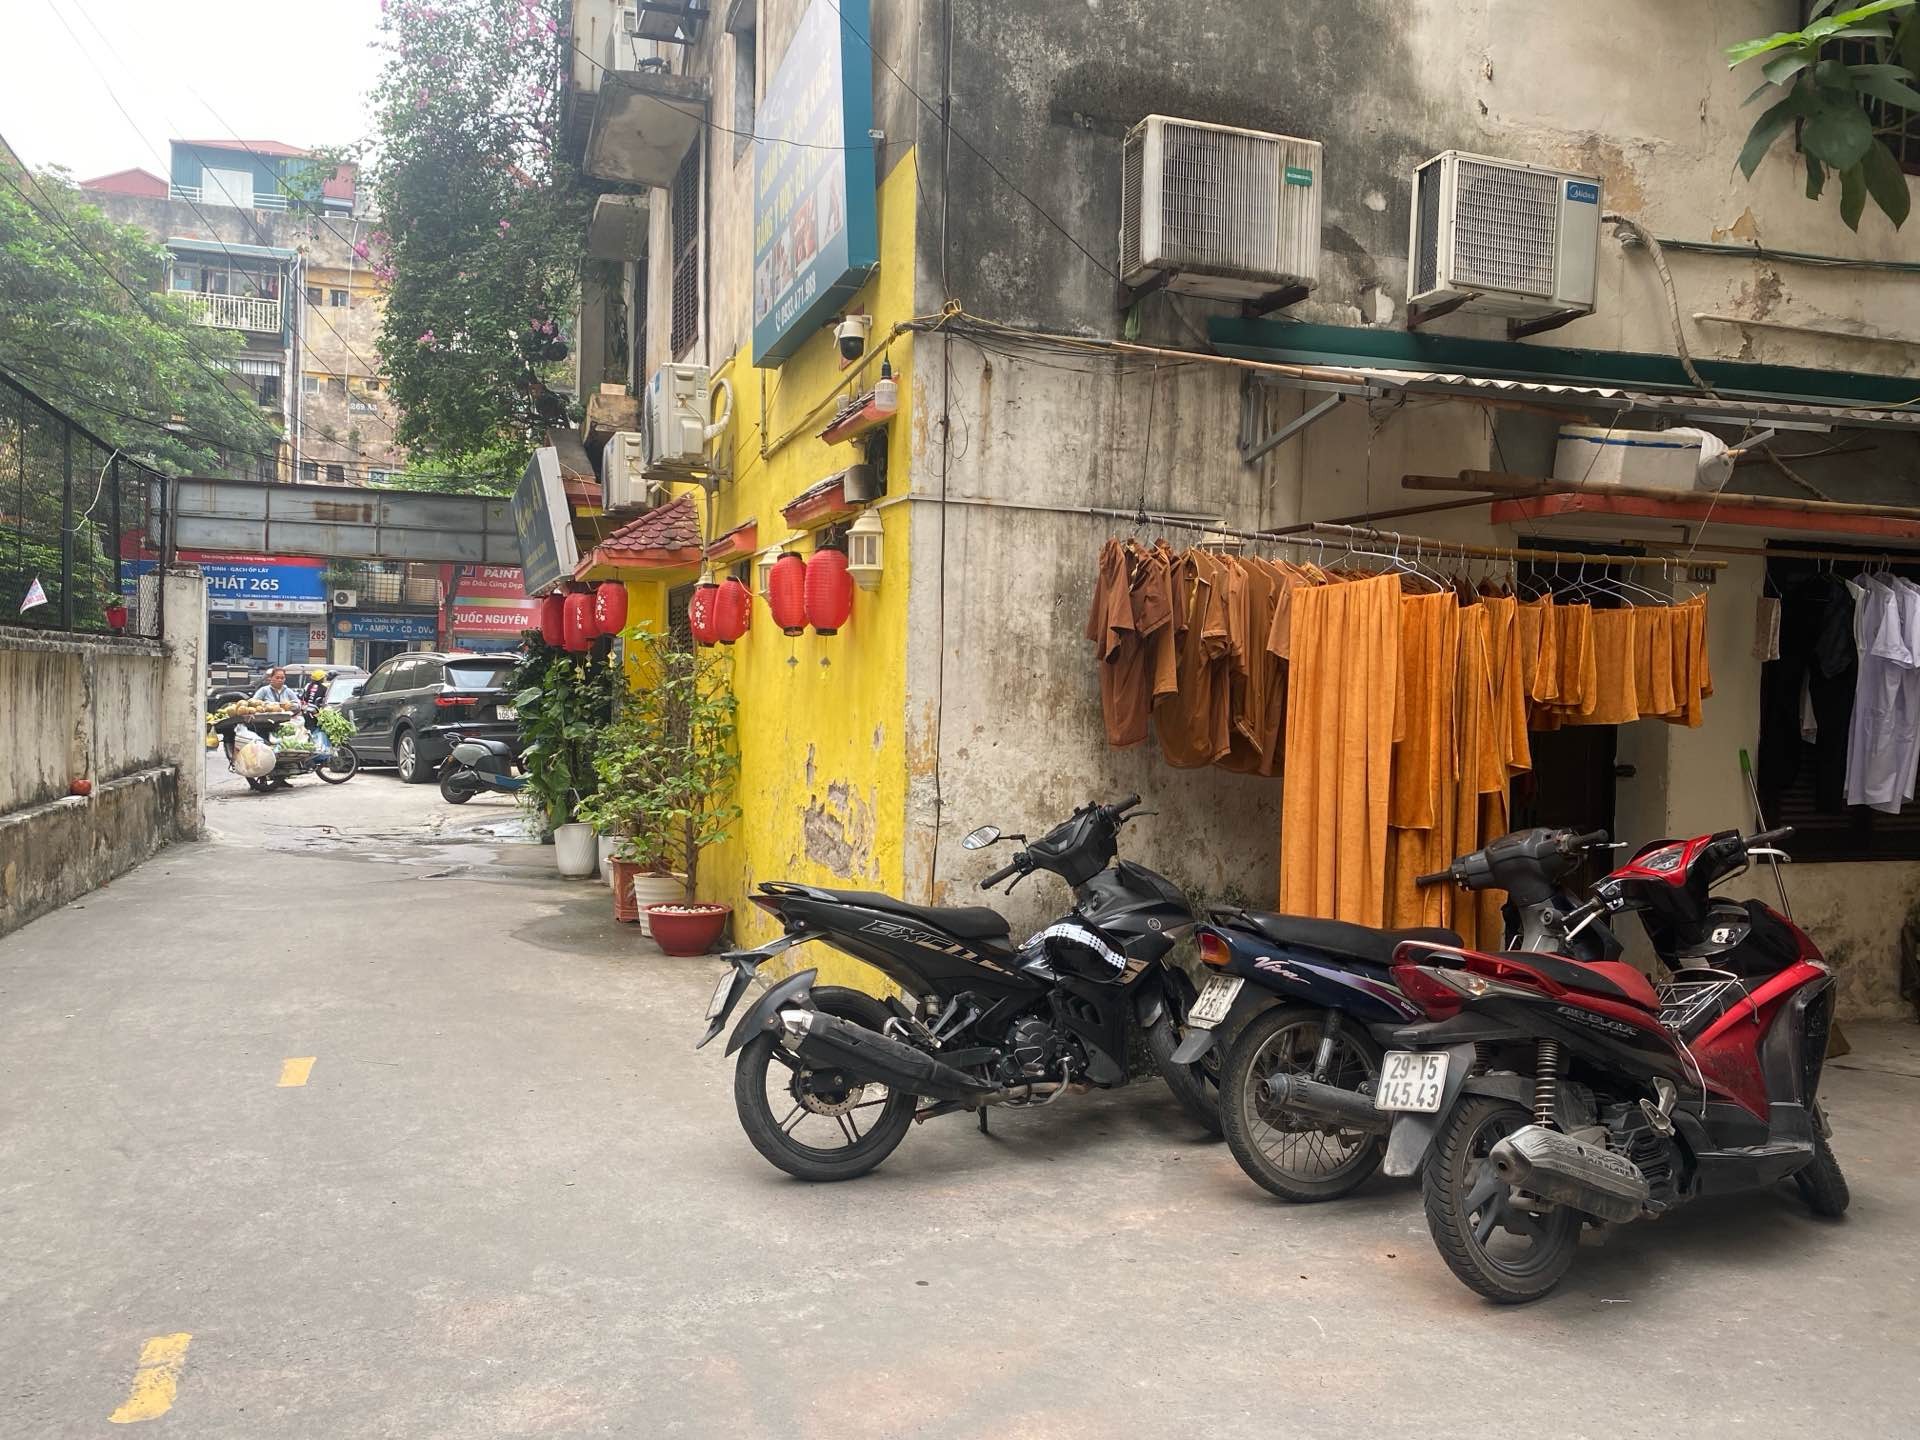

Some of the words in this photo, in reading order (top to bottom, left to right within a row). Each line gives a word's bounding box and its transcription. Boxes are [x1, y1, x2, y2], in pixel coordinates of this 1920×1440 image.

[484, 570, 521, 579] PAINT
[206, 575, 247, 590] PHÁT
[250, 578, 279, 590] 265
[353, 624, 364, 632] TV
[369, 624, 396, 633] AMPLY
[311, 630, 326, 640] 265
[1390, 1055, 1440, 1080] 29-Y5
[1384, 1082, 1439, 1108] 145.43
